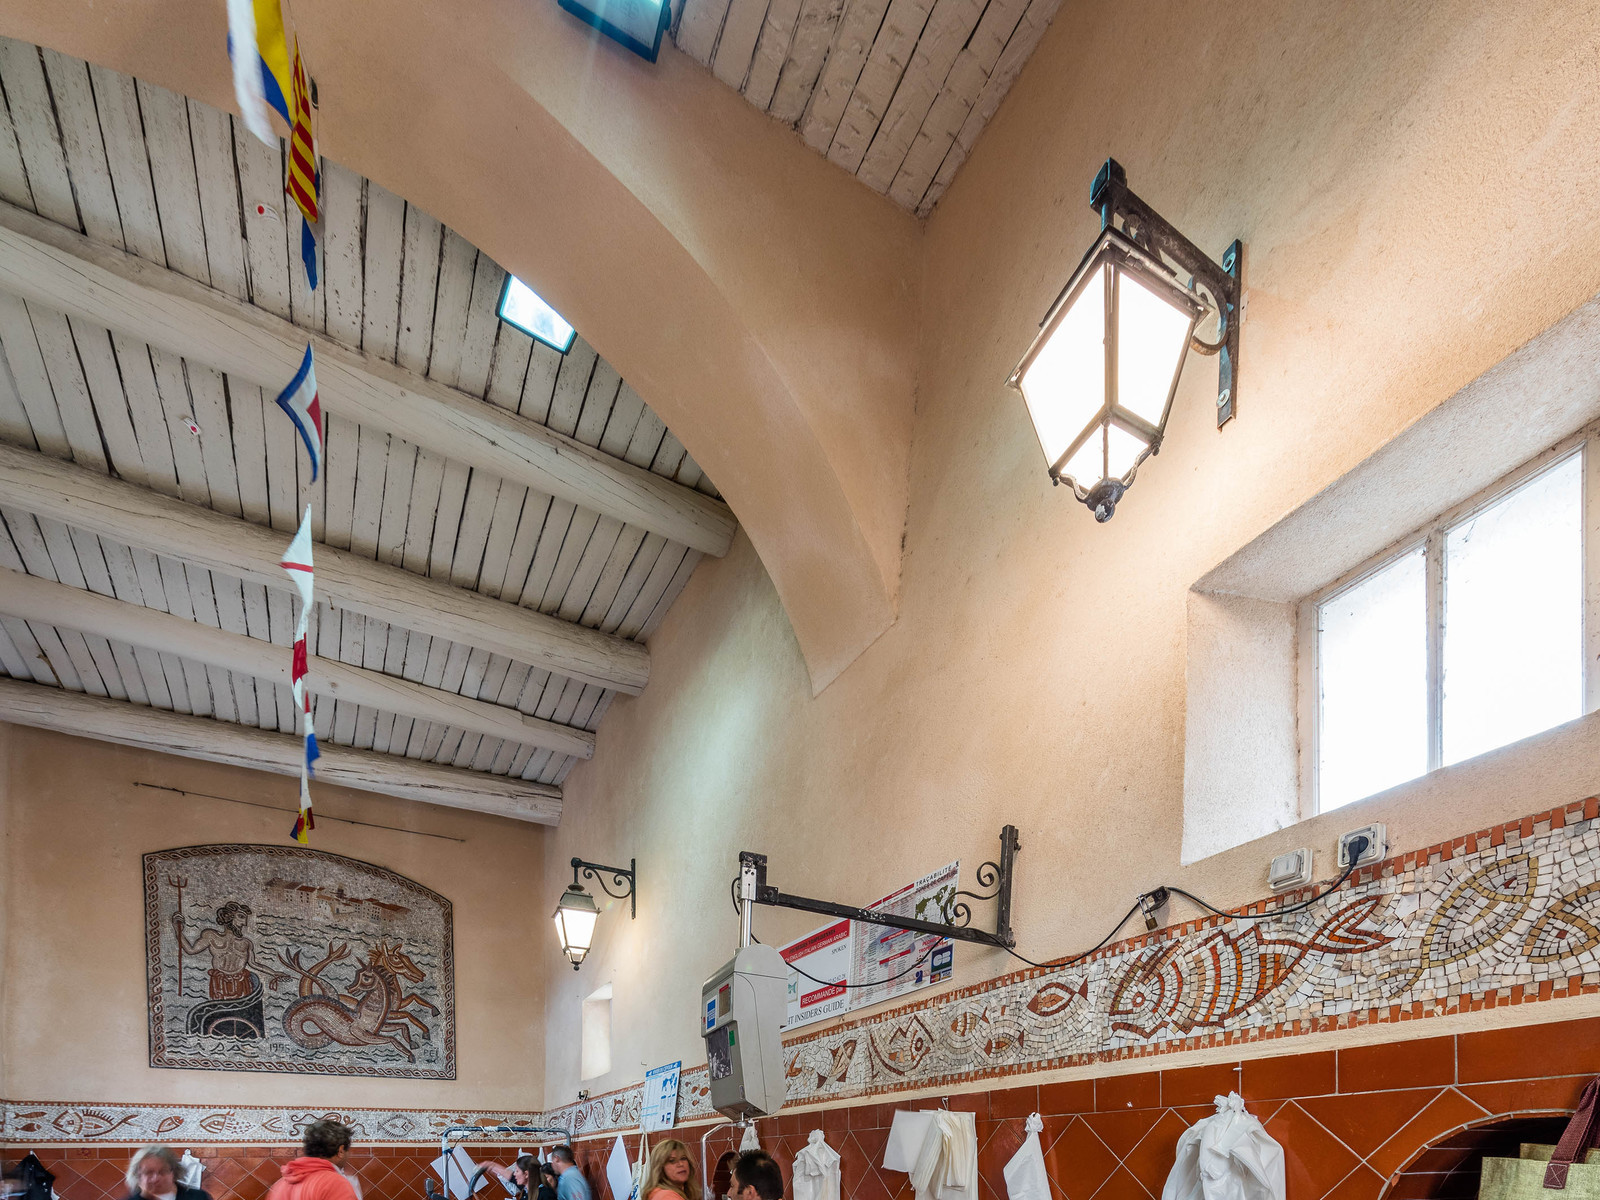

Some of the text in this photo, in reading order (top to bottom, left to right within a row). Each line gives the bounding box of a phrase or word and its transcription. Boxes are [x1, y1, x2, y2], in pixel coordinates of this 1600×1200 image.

[933, 951, 951, 967] CB
[794, 1006, 822, 1023] INSIDERS
[823, 999, 845, 1014] GUIDE
